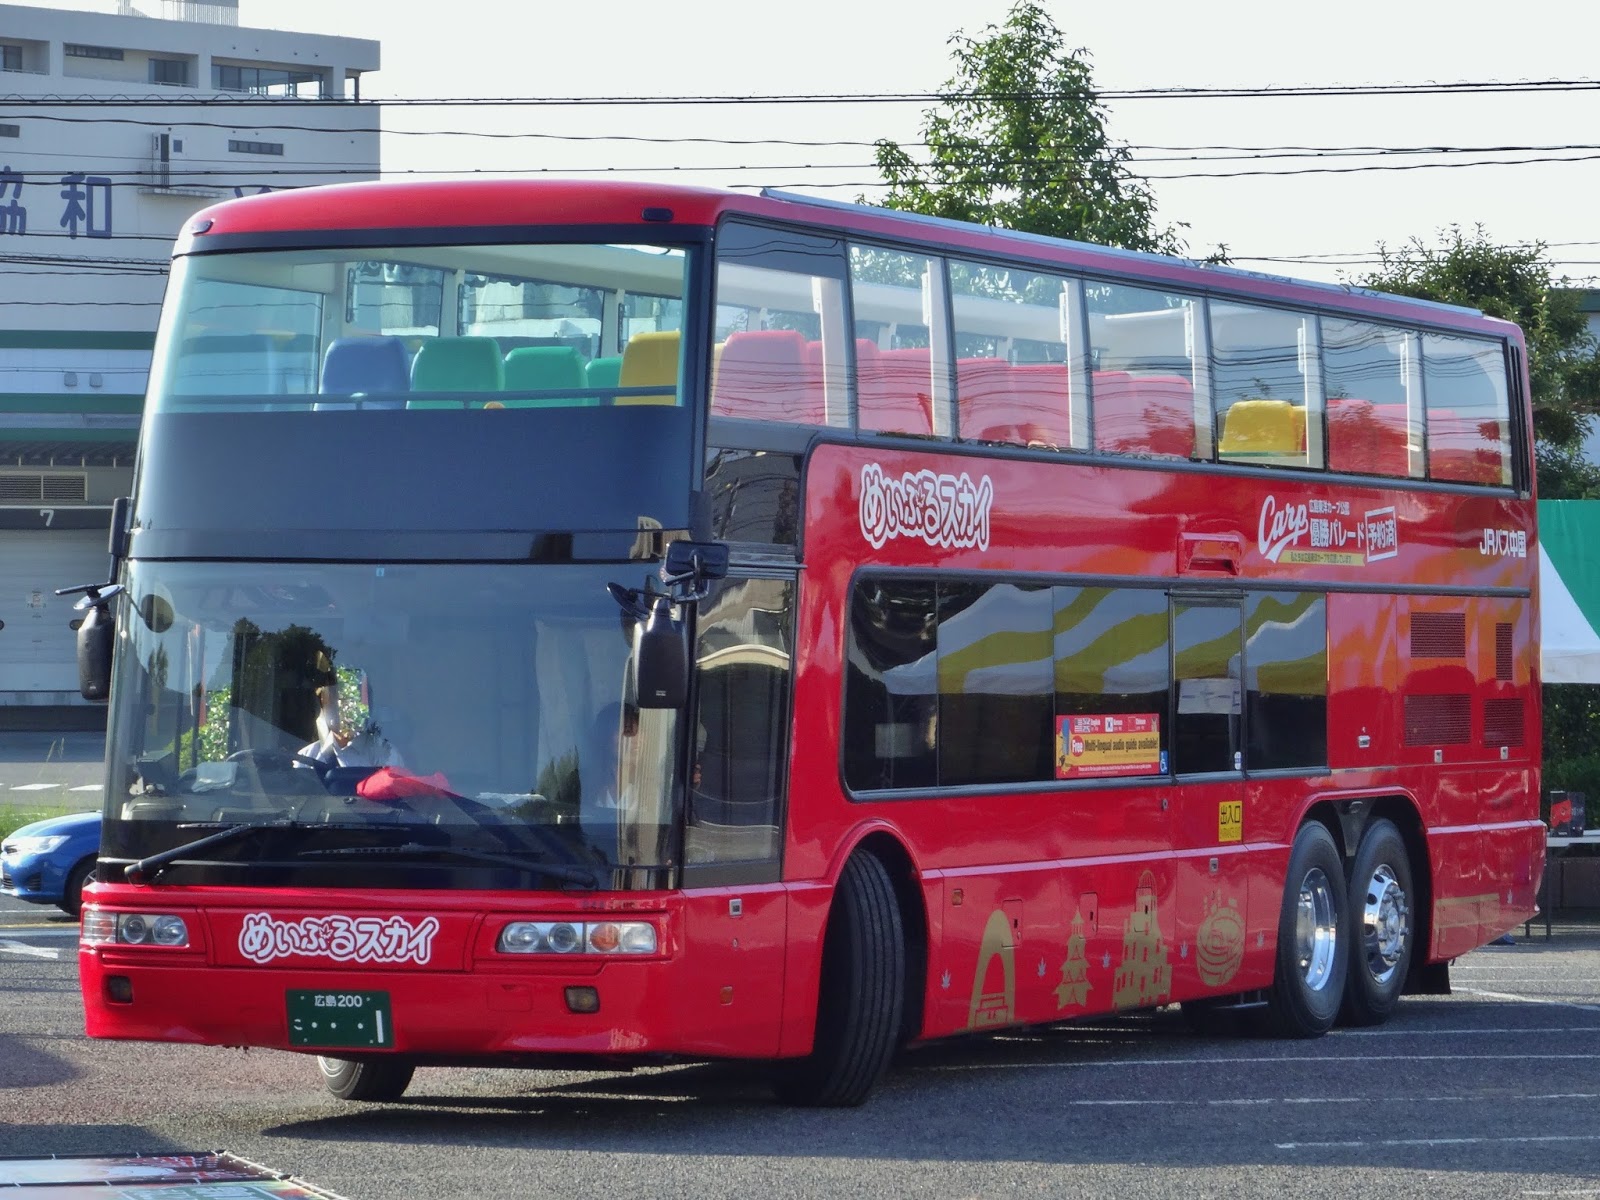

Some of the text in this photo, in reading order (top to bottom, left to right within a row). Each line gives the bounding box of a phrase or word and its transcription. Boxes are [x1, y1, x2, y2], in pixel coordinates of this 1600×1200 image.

[40, 509, 54, 526] 7
[859, 462, 993, 551] めいぷるスカイ
[1258, 495, 1309, 563] Carp
[1310, 517, 1365, 548] 優勝パレード
[1368, 518, 1395, 551] 予約済
[1480, 528, 1527, 558] JRバス中国
[1220, 803, 1241, 825] 出入口
[238, 912, 440, 965] めいぷるスカイ
